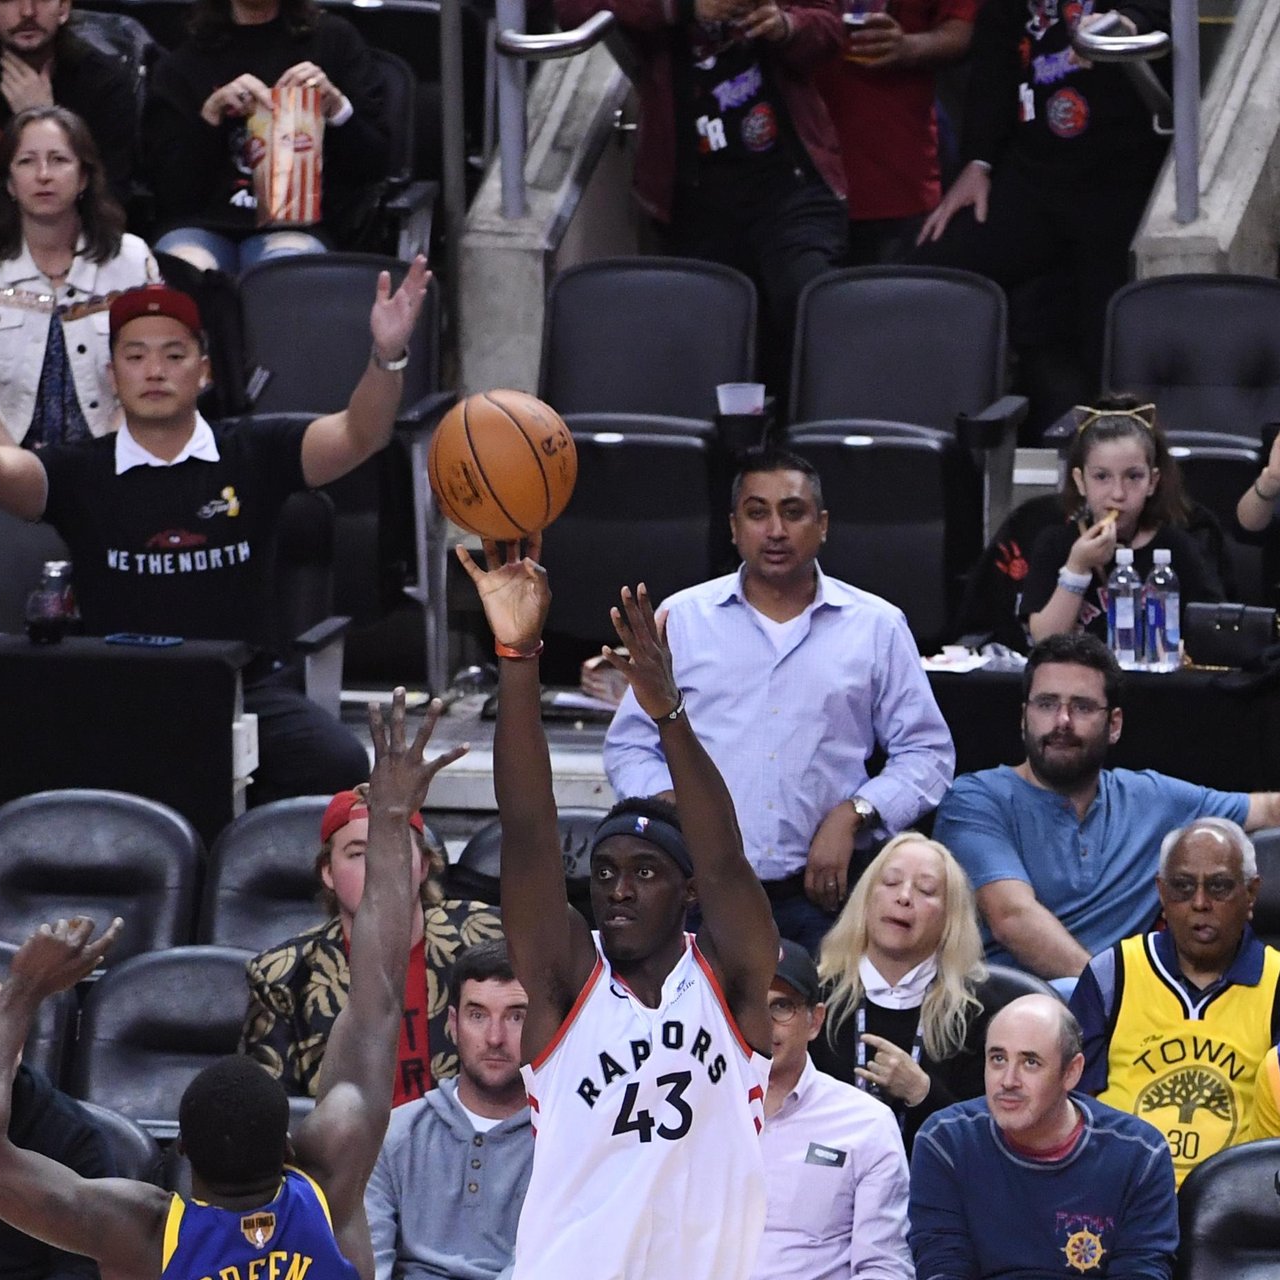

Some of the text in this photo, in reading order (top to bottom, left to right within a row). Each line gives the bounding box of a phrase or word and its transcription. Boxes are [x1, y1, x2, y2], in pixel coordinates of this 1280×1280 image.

[107, 540, 251, 575] WE THE NORTH
[1132, 1035, 1246, 1082] TOWN
[611, 1070, 694, 1143] 43
[1167, 1129, 1200, 1160] 30
